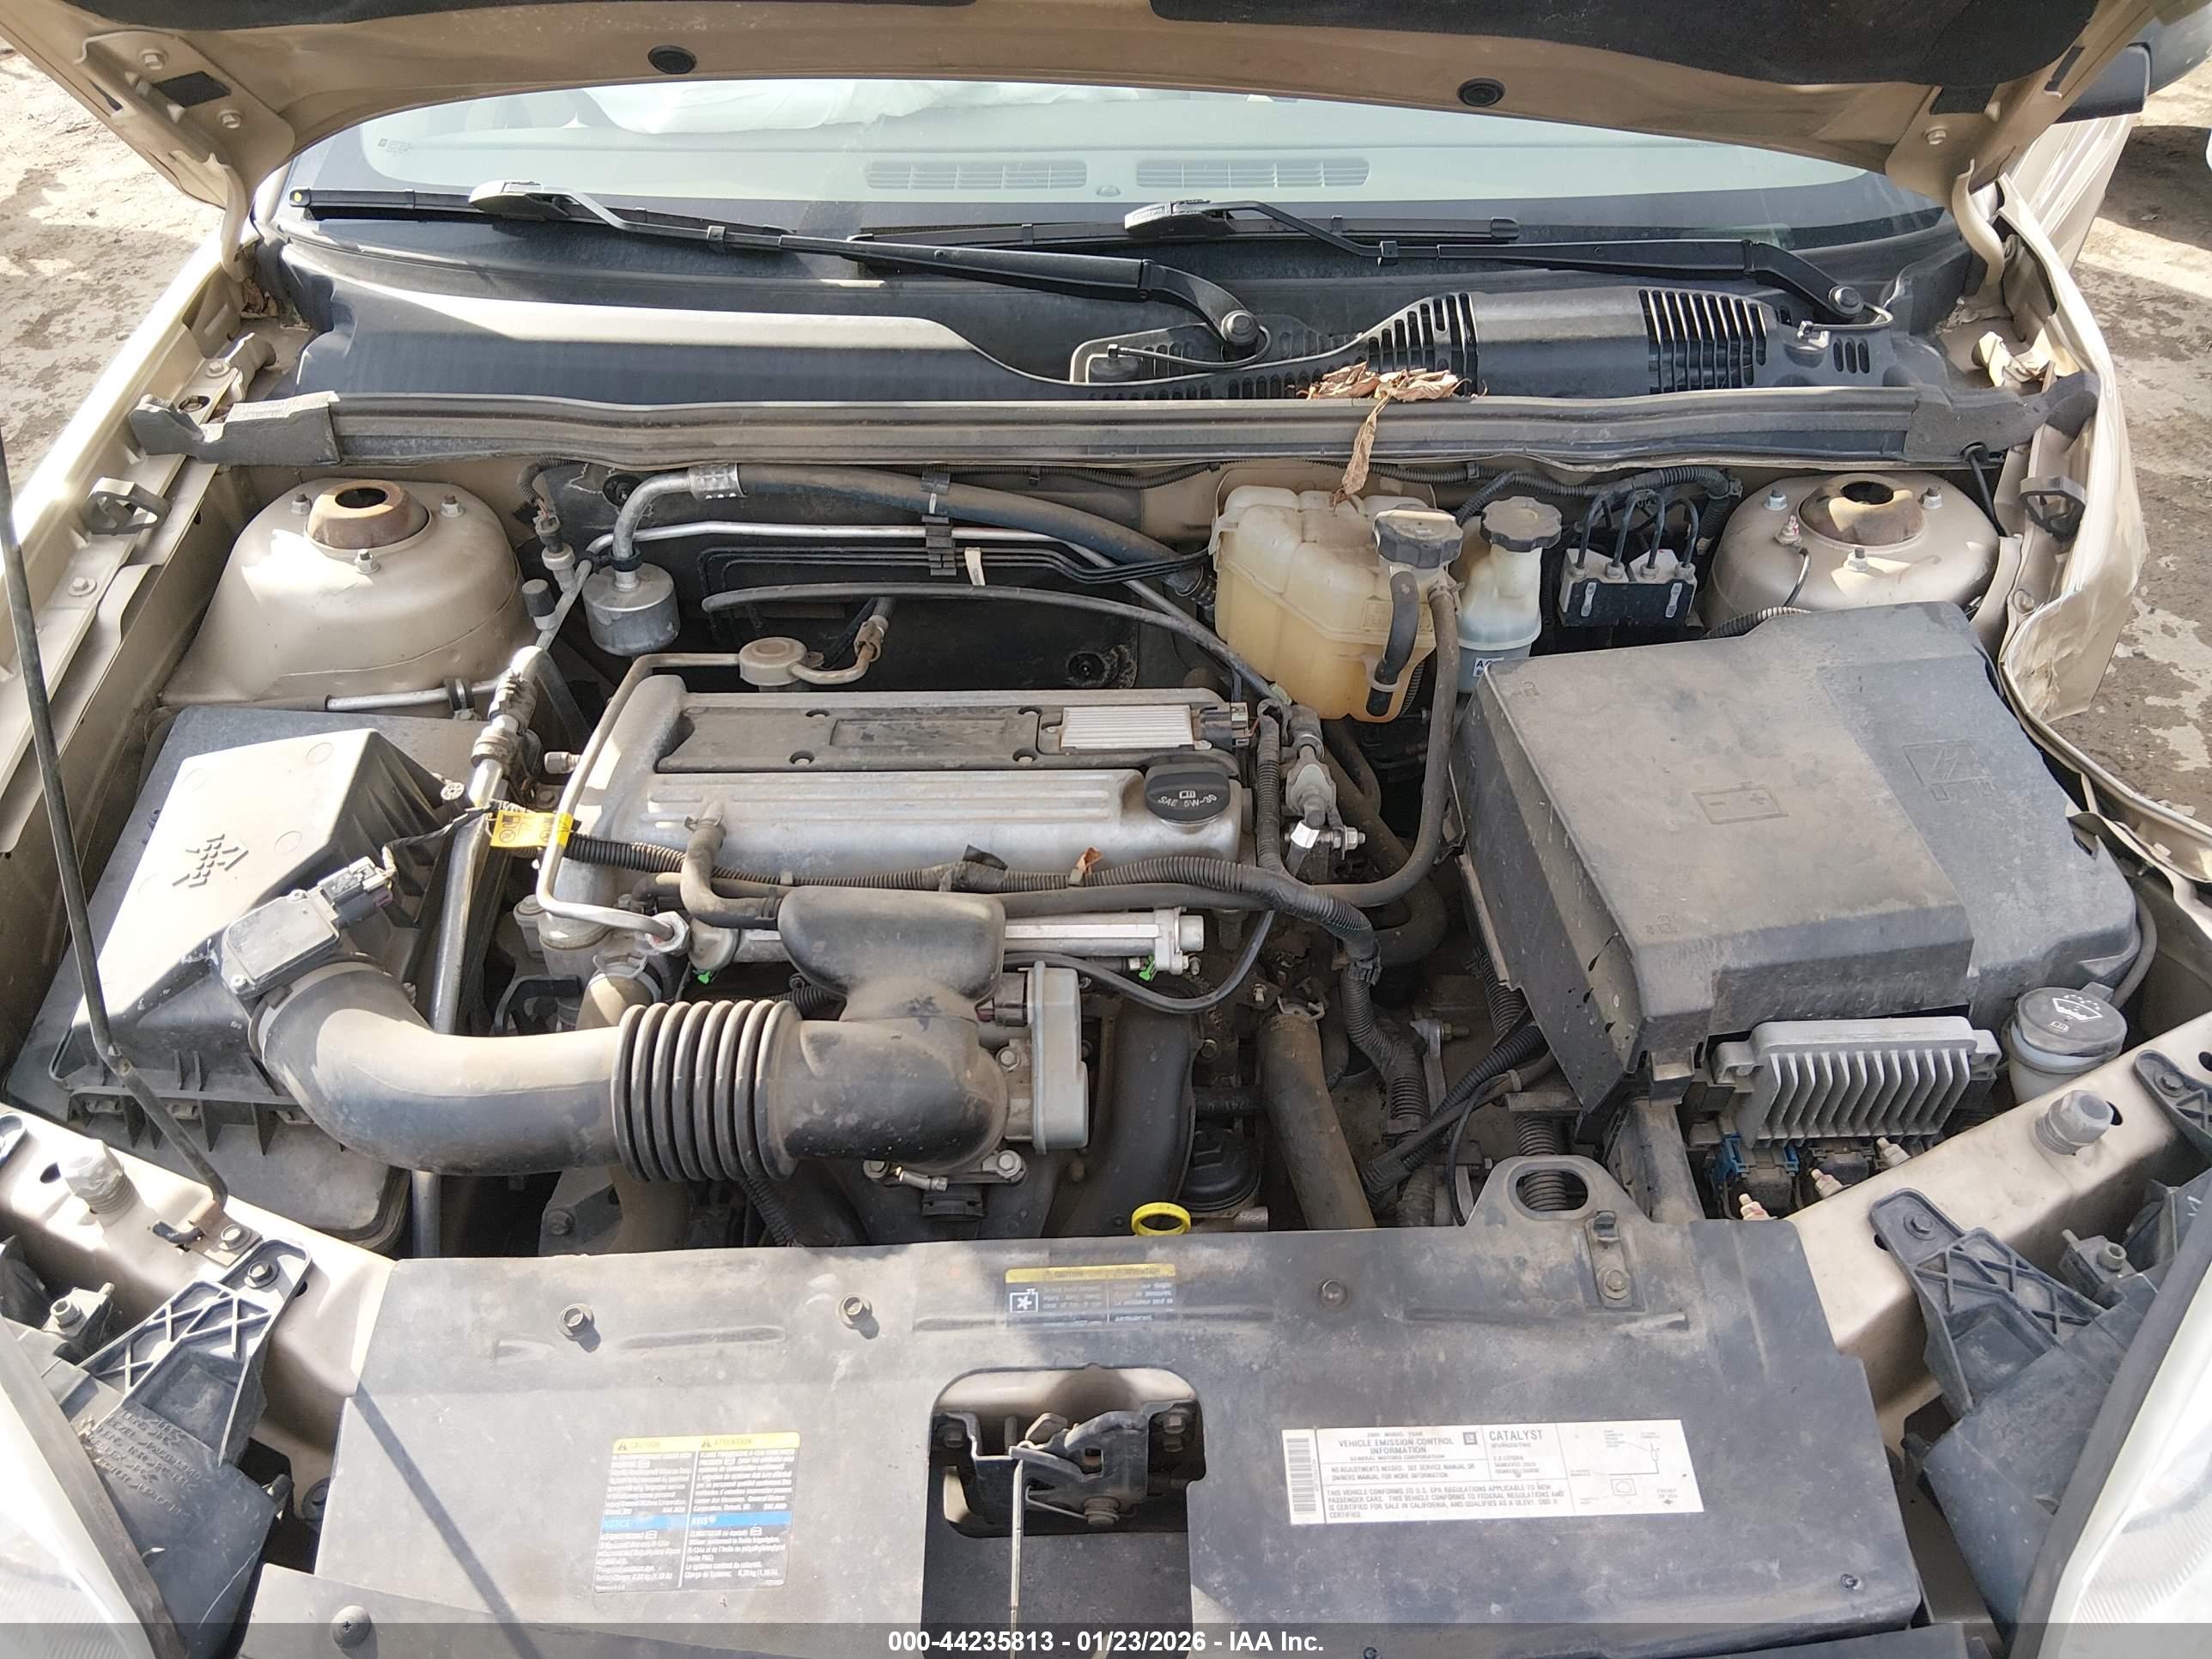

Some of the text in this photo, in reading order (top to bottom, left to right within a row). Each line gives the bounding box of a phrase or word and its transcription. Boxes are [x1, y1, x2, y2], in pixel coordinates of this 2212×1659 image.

[1158, 793, 1218, 807] SAE 5W-30
[1488, 1429, 1544, 1441] CATALYST
[1374, 1437, 1413, 1446] EMISSION
[604, 1518, 632, 1528] NOTICE
[690, 1516, 708, 1526] AVIS
